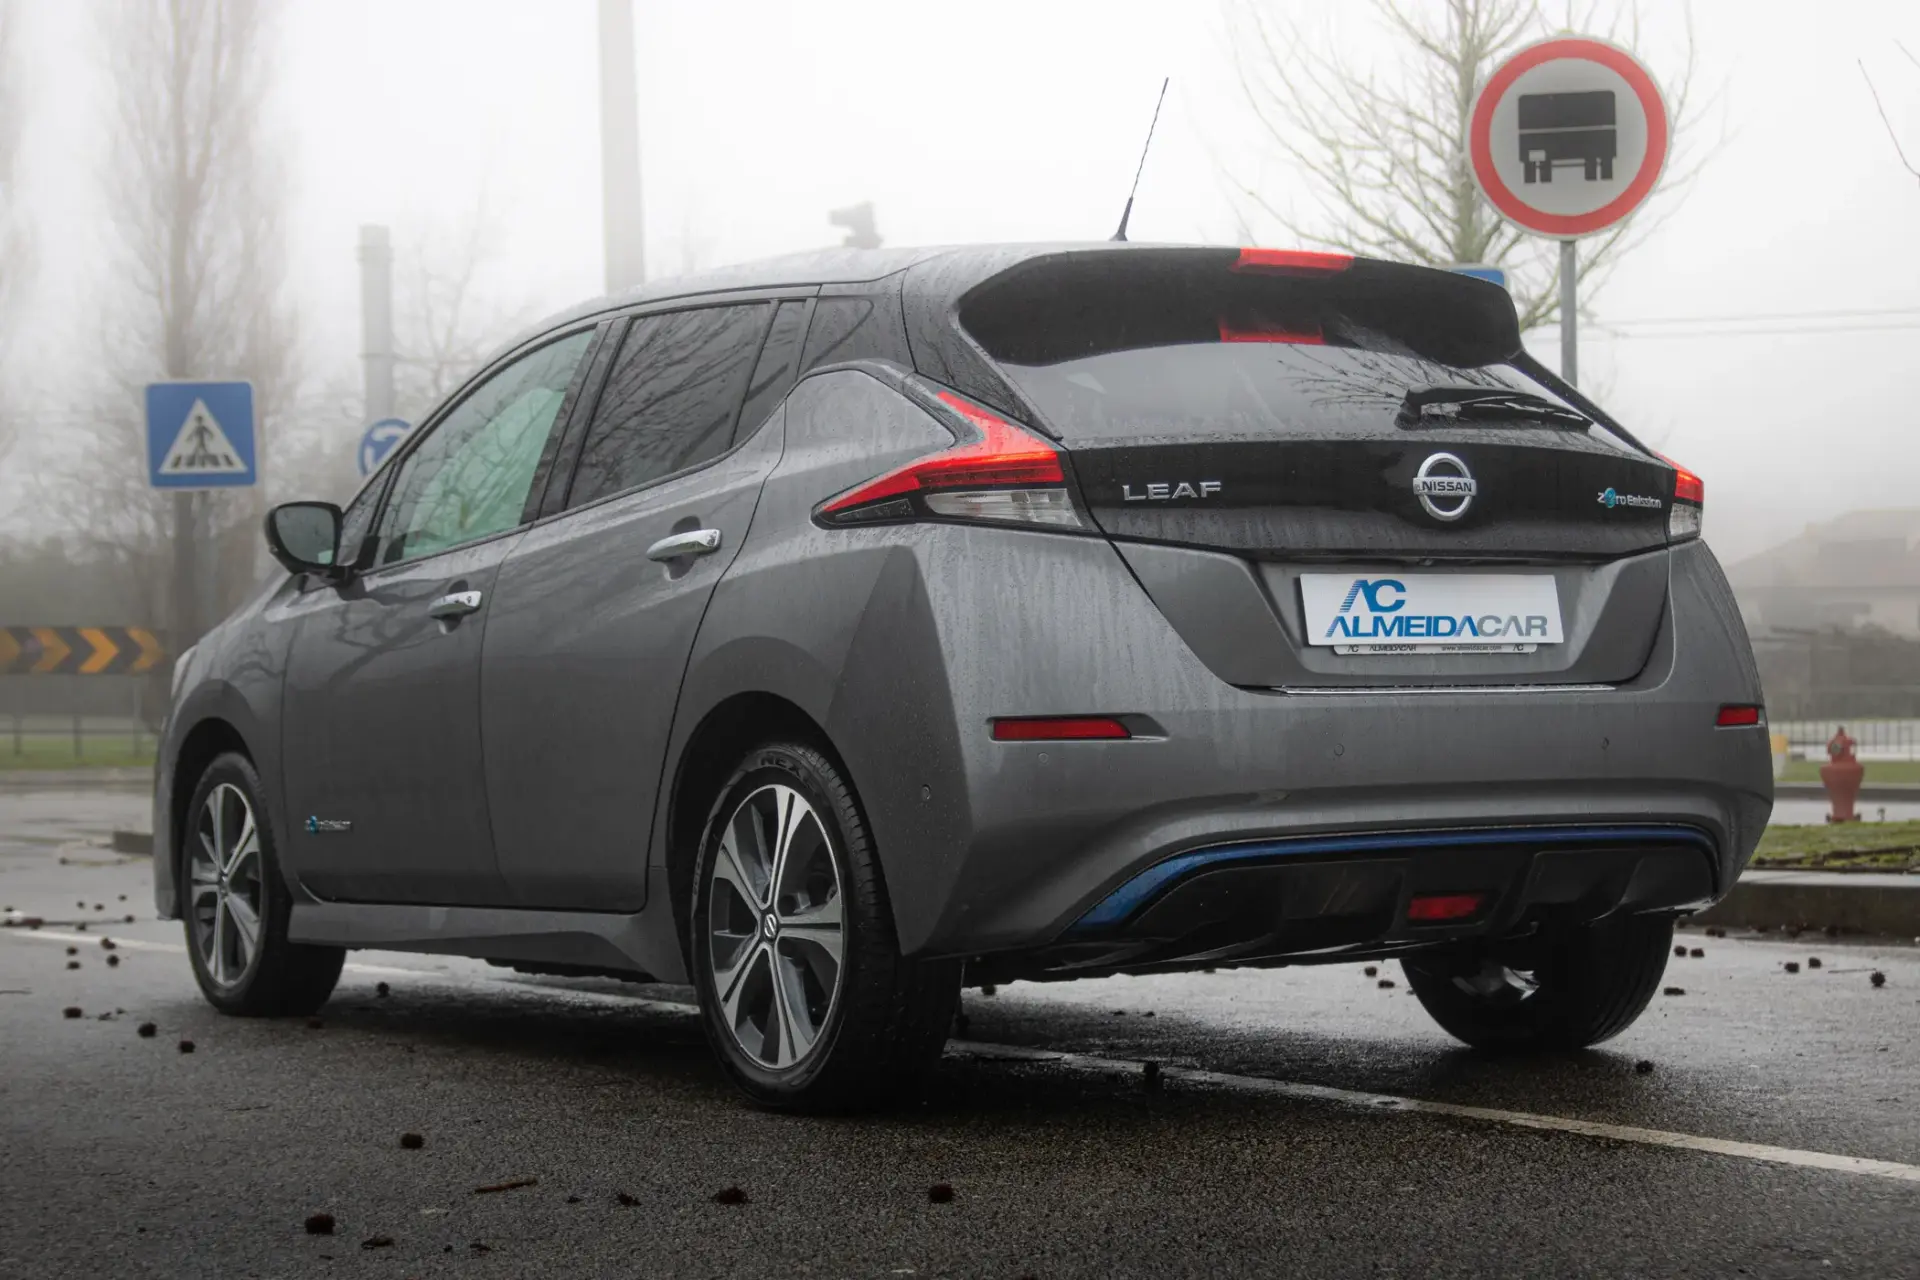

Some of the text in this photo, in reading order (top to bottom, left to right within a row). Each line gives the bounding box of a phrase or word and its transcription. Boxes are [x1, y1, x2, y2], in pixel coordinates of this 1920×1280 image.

[1122, 481, 1221, 500] LEAF
[1422, 481, 1472, 492] NISSAN
[1339, 579, 1406, 613] AC
